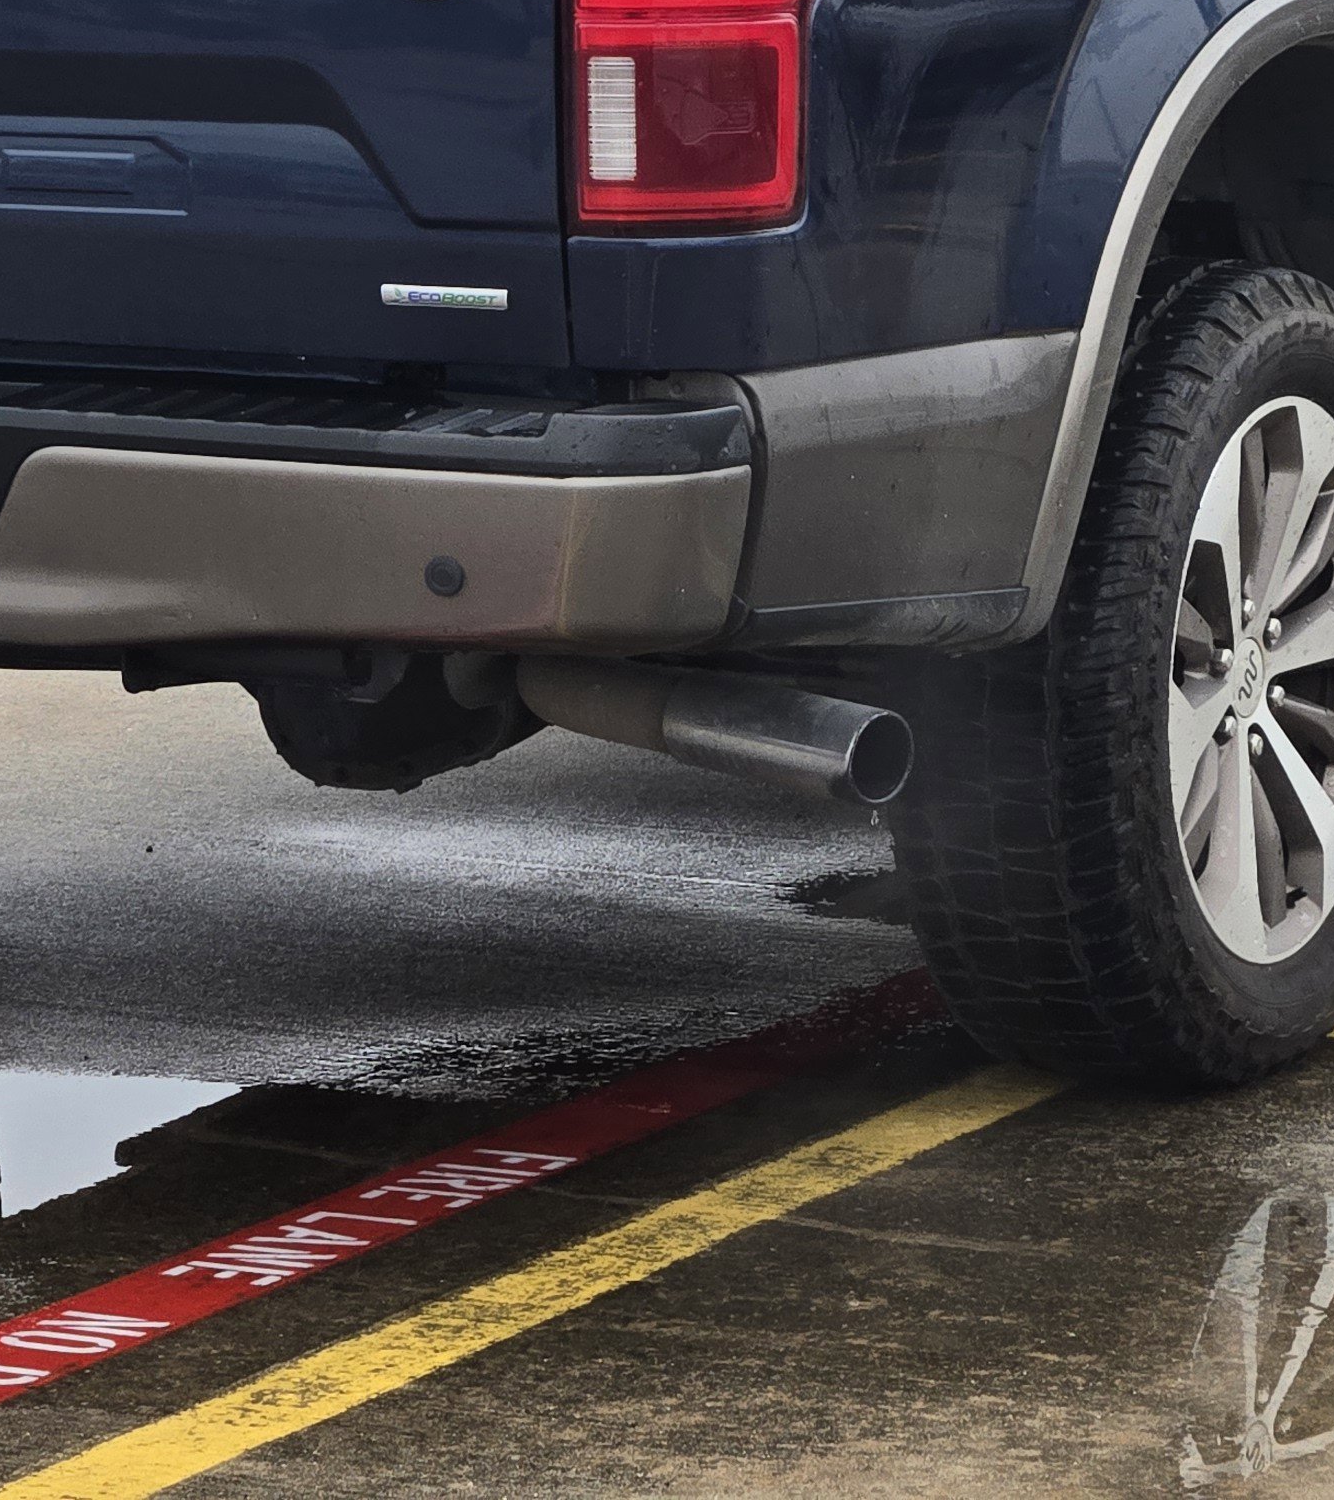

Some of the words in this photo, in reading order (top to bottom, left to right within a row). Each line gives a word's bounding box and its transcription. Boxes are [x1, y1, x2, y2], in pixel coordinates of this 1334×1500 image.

[360, 1148, 577, 1208] FIRE
[161, 1210, 417, 1286] LANE
[0, 1310, 170, 1355] NO
